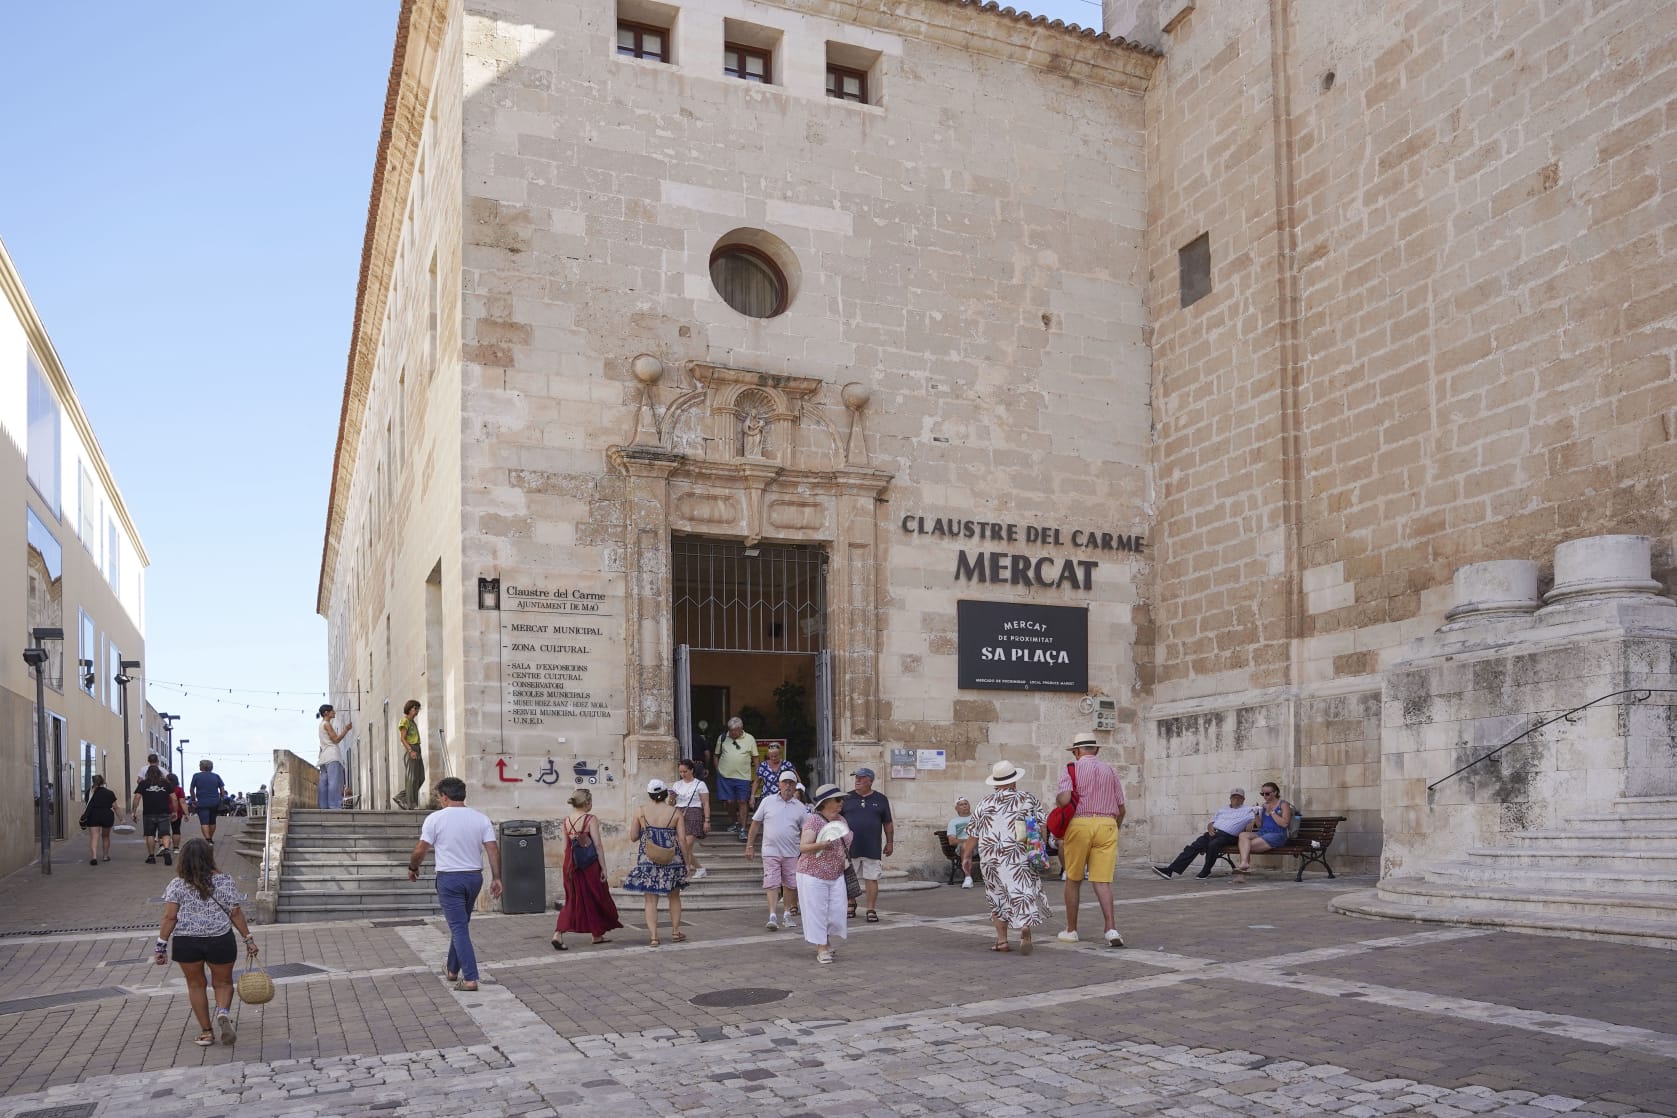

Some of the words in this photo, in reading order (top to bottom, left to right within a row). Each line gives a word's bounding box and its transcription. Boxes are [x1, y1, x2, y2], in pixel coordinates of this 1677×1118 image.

[902, 515, 1018, 542] CLAUSTRE
[1026, 525, 1064, 546] DEL
[1071, 530, 1145, 553] CARME
[954, 550, 1099, 590] MERCAT
[506, 585, 549, 598] Claustre
[553, 588, 568, 599] del
[572, 589, 606, 601] Carme
[517, 600, 567, 610] AJUNTAMENT
[570, 602, 579, 611] DE
[511, 623, 548, 633] MERCAT
[553, 626, 603, 636] MUNICIPAL
[1003, 620, 1047, 633] MERCAT
[1010, 635, 1053, 643] PROXIMITAT
[511, 643, 536, 652] ZONA
[981, 646, 1006, 661] SA
[1011, 648, 1070, 666] PLAÇA
[511, 672, 541, 680] CENTRE
[544, 673, 583, 681] CULTURAL
[511, 681, 564, 689] CONSERVATORI
[546, 691, 591, 699] MUNICIPALS
[539, 709, 577, 717] MUNICIPAL
[579, 710, 611, 718] CULTURA
